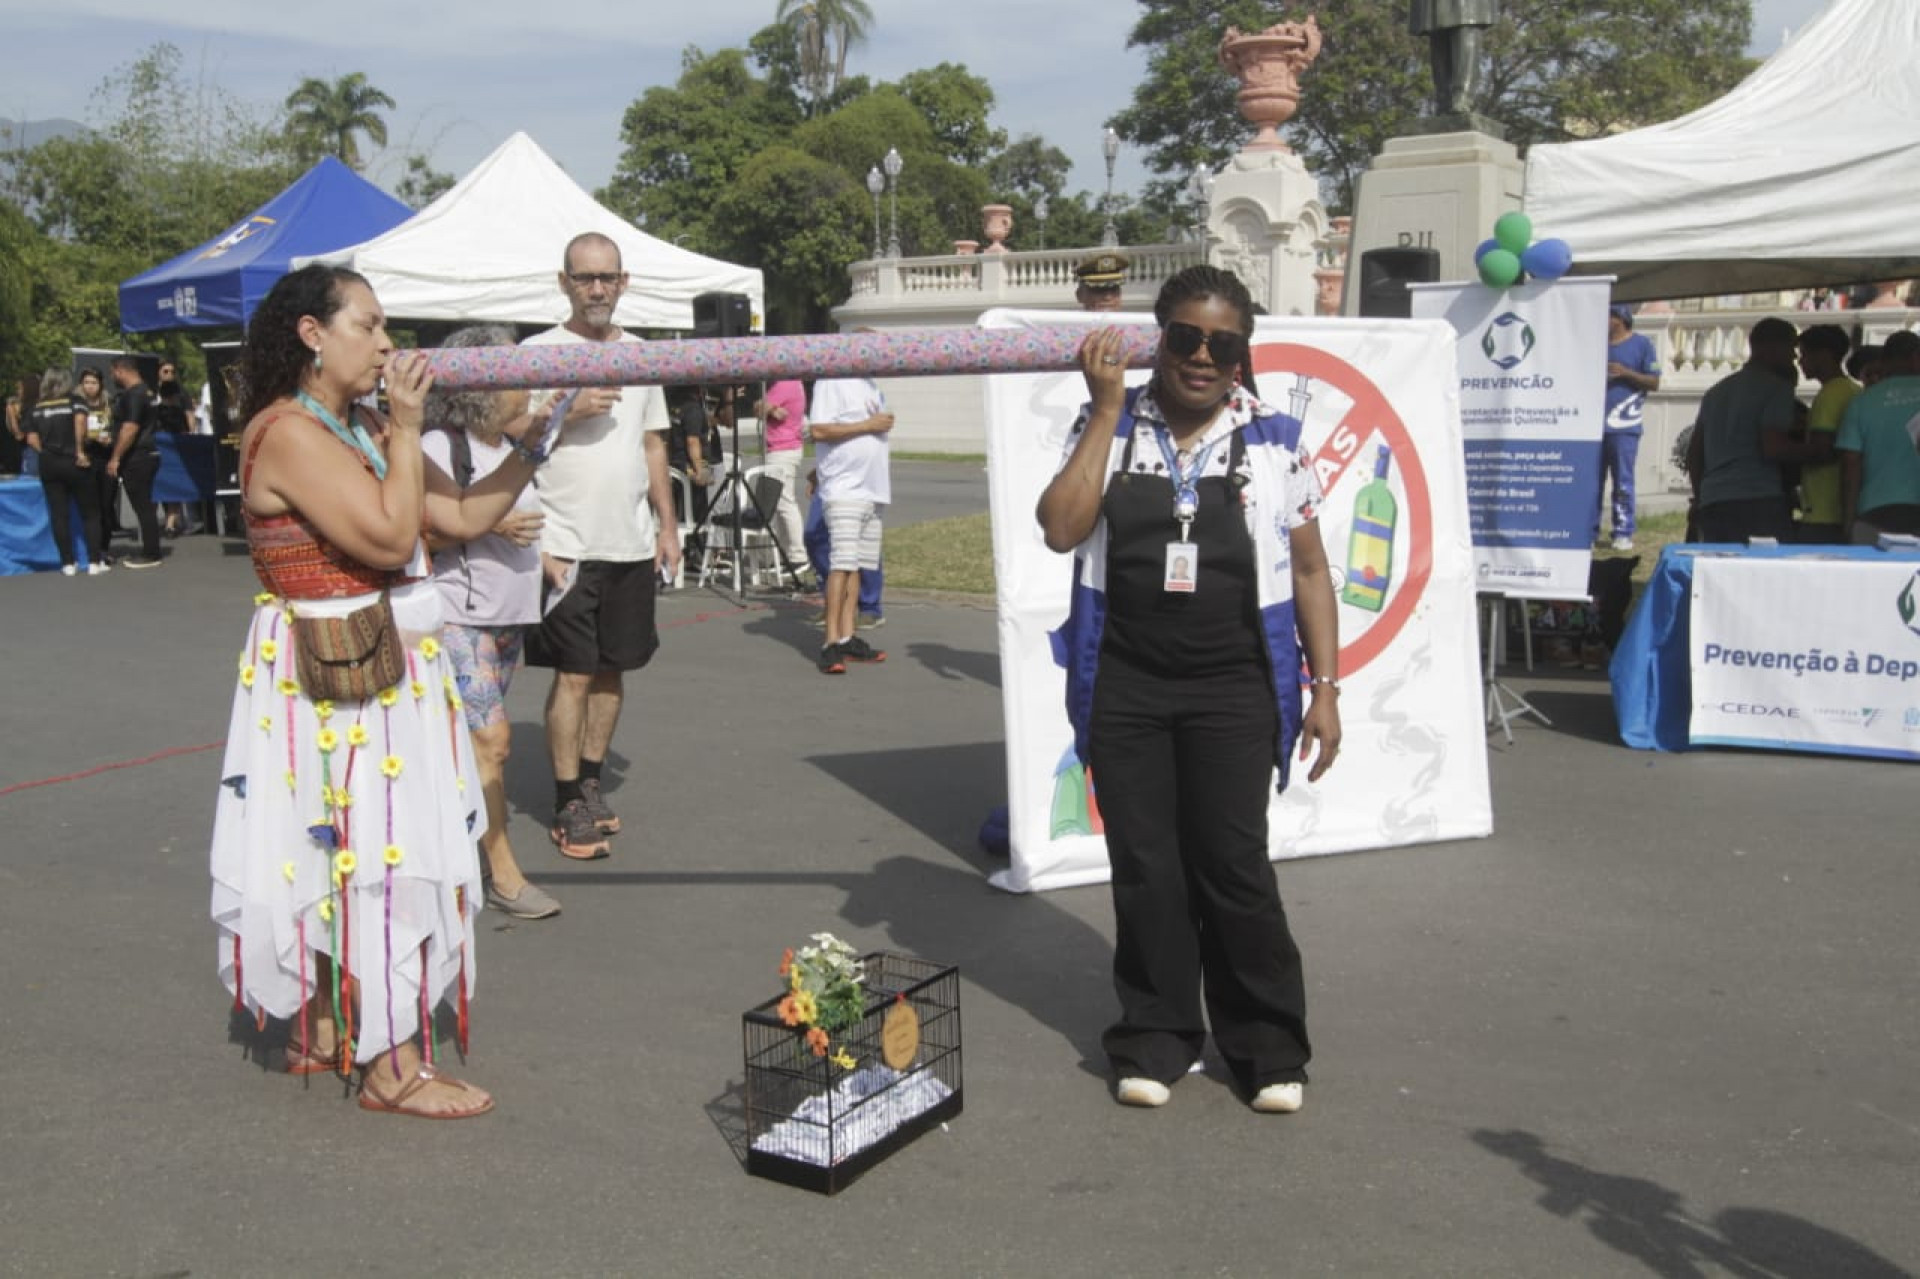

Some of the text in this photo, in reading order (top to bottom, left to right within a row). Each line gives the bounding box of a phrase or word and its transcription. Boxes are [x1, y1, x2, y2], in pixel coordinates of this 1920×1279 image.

[1314, 425, 1358, 487] AS
[1704, 644, 1920, 682] Prevenção à Dep
[1721, 702, 1800, 718] CEDAE
